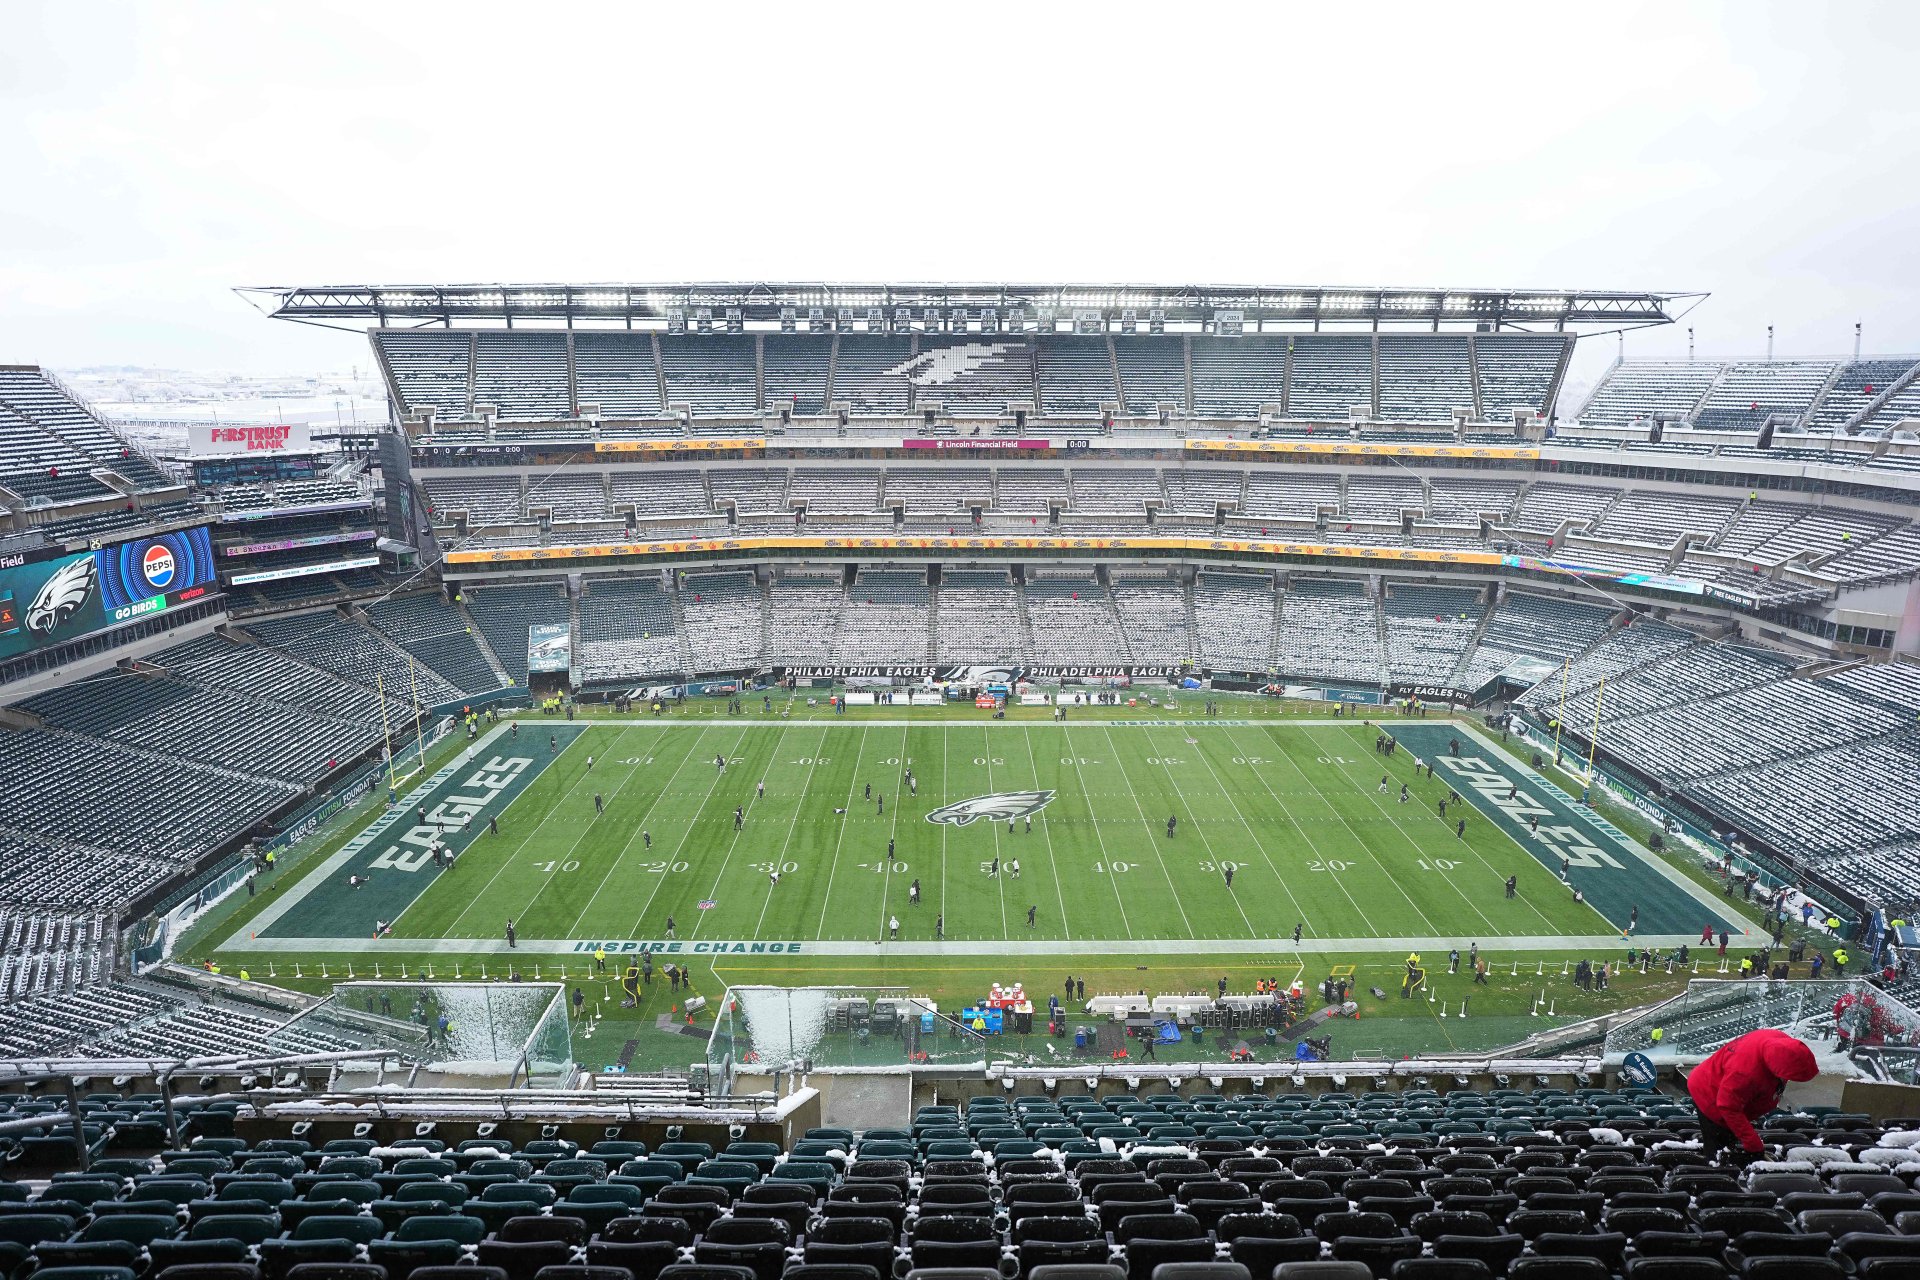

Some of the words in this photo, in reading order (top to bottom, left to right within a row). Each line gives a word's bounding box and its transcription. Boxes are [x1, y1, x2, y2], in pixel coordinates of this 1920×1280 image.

[247, 439, 285, 450] BANK
[91, 540, 101, 550] 25
[1, 554, 24, 569] Field
[146, 559, 173, 573] PEPSI
[179, 587, 204, 600] verizon
[115, 606, 130, 620] GO
[131, 599, 158, 616] BIRDS
[785, 667, 880, 676] PHILADELPHIA
[886, 667, 936, 676] EAGLES
[1031, 667, 1125, 676] PHILADELPHIA
[1505, 677, 1530, 687] GEICO
[1413, 686, 1453, 698] EAGLES
[1455, 692, 1468, 700] FLY
[1584, 764, 1608, 786] EGLES
[1608, 781, 1633, 801] AUTISM
[1635, 796, 1683, 832] FOUNDAON
[342, 842, 364, 851] IT
[365, 810, 404, 837] TAKES
[400, 792, 426, 807] ALL
[421, 780, 439, 792] OF
[434, 768, 455, 778] US
[367, 755, 534, 872] EAGLES
[1435, 755, 1627, 870] EAGLES
[1526, 773, 1574, 804] INSPIRE
[1572, 806, 1631, 842] CHANGE
[289, 816, 317, 842] EAGLES
[318, 799, 342, 822] AUTISM
[540, 860, 580, 872] 10
[646, 861, 689, 873] 20
[758, 861, 798, 873] 30
[869, 861, 909, 873] 40
[1090, 861, 1129, 873] 40
[1199, 860, 1238, 872] 30
[1306, 859, 1347, 871] 20
[1416, 858, 1454, 870] 10
[573, 941, 683, 953] INSPIRE
[693, 942, 802, 953] CHANGE
